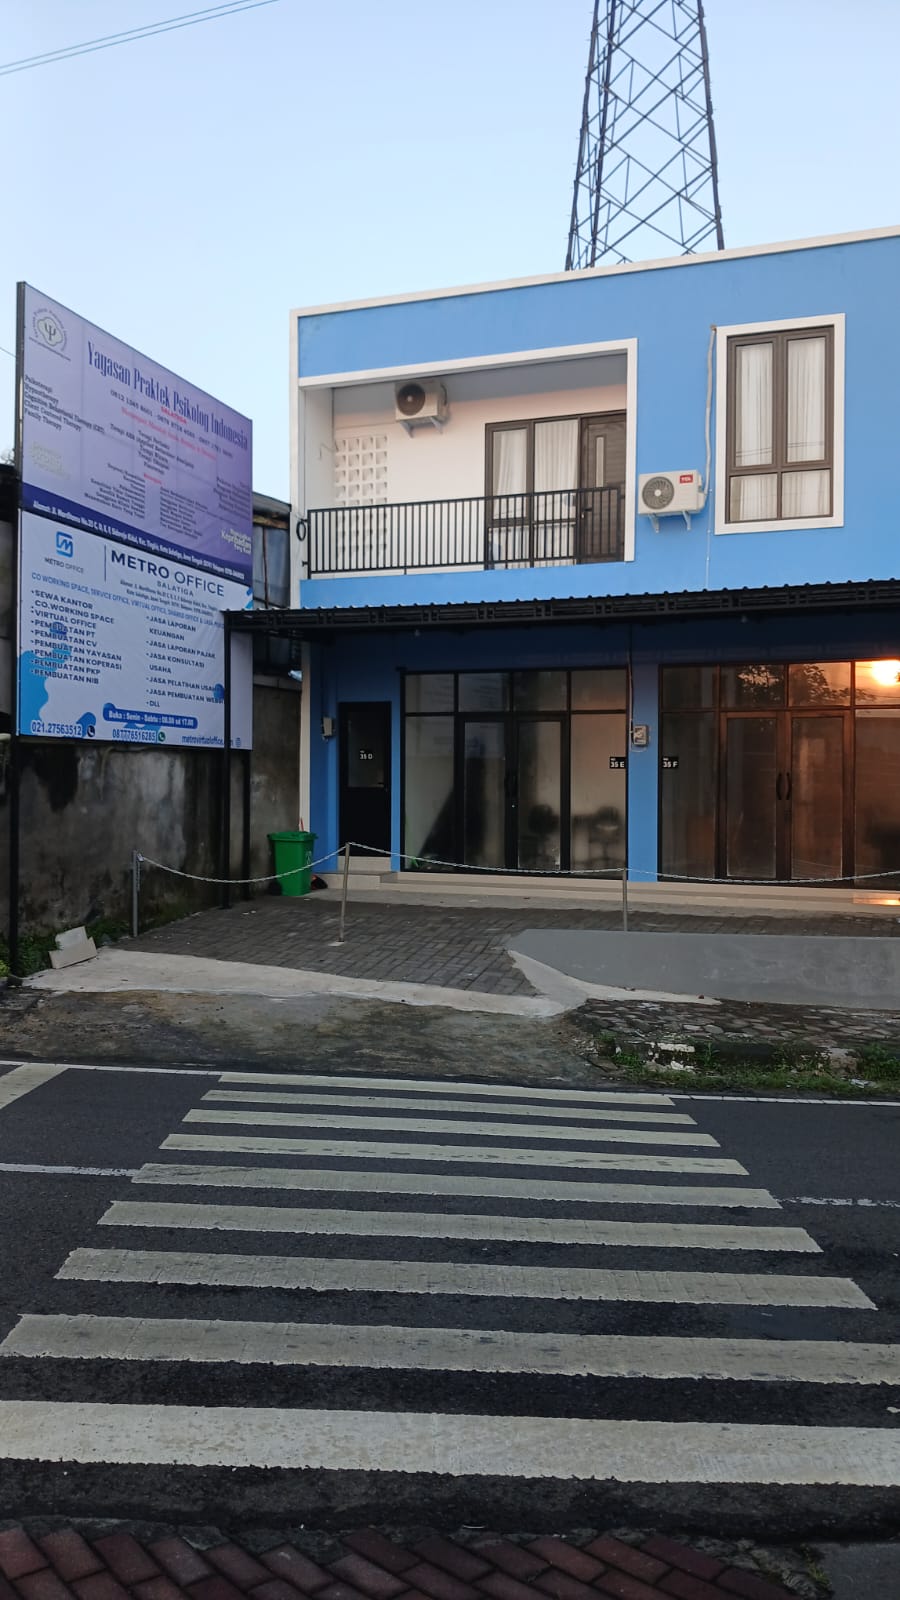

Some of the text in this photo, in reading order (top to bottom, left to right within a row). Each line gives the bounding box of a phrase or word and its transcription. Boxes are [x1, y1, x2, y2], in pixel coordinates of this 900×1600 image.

[87, 340, 130, 389] Yayasan
[133, 366, 169, 410] Praktek
[173, 390, 208, 431] Psikolog
[211, 412, 247, 453] Indonesia
[44, 556, 83, 573] METRO OFFICE
[111, 549, 168, 580] METRO
[174, 569, 224, 596] OFFICE
[31, 572, 41, 581] CO
[42, 574, 69, 588] WORKING
[156, 580, 193, 597] SALATIGA
[34, 589, 93, 609] SEWA KANTOR
[34, 599, 114, 624] CO.WORKING SPACE
[34, 609, 96, 629] VIRTUAL OFFICE
[34, 619, 95, 637] PEMBUATAN PT
[149, 614, 195, 632] JASA LAPORAN
[34, 629, 97, 647] PEMBUATAN CV
[149, 627, 184, 641] KEUANGAN
[34, 639, 121, 661] PEMBUATAN YAYASAN
[149, 640, 215, 658] JASA LAPORAN PAJAK
[34, 649, 121, 669] PEMBUATAN KOPERASI
[34, 659, 100, 675] PEMBUATAN PKP
[149, 651, 204, 668] JASA KONSULTASI
[34, 669, 99, 684] PEMBUATAN NIB
[149, 664, 171, 674] USAHA
[148, 676, 165, 684] JASA
[167, 678, 199, 689] PELATIHAN
[148, 688, 165, 696] JASA
[167, 690, 204, 701] PEMBUATAN
[108, 710, 121, 719] Buka
[126, 712, 140, 721] Senin
[32, 721, 81, 736] 021.27563512
